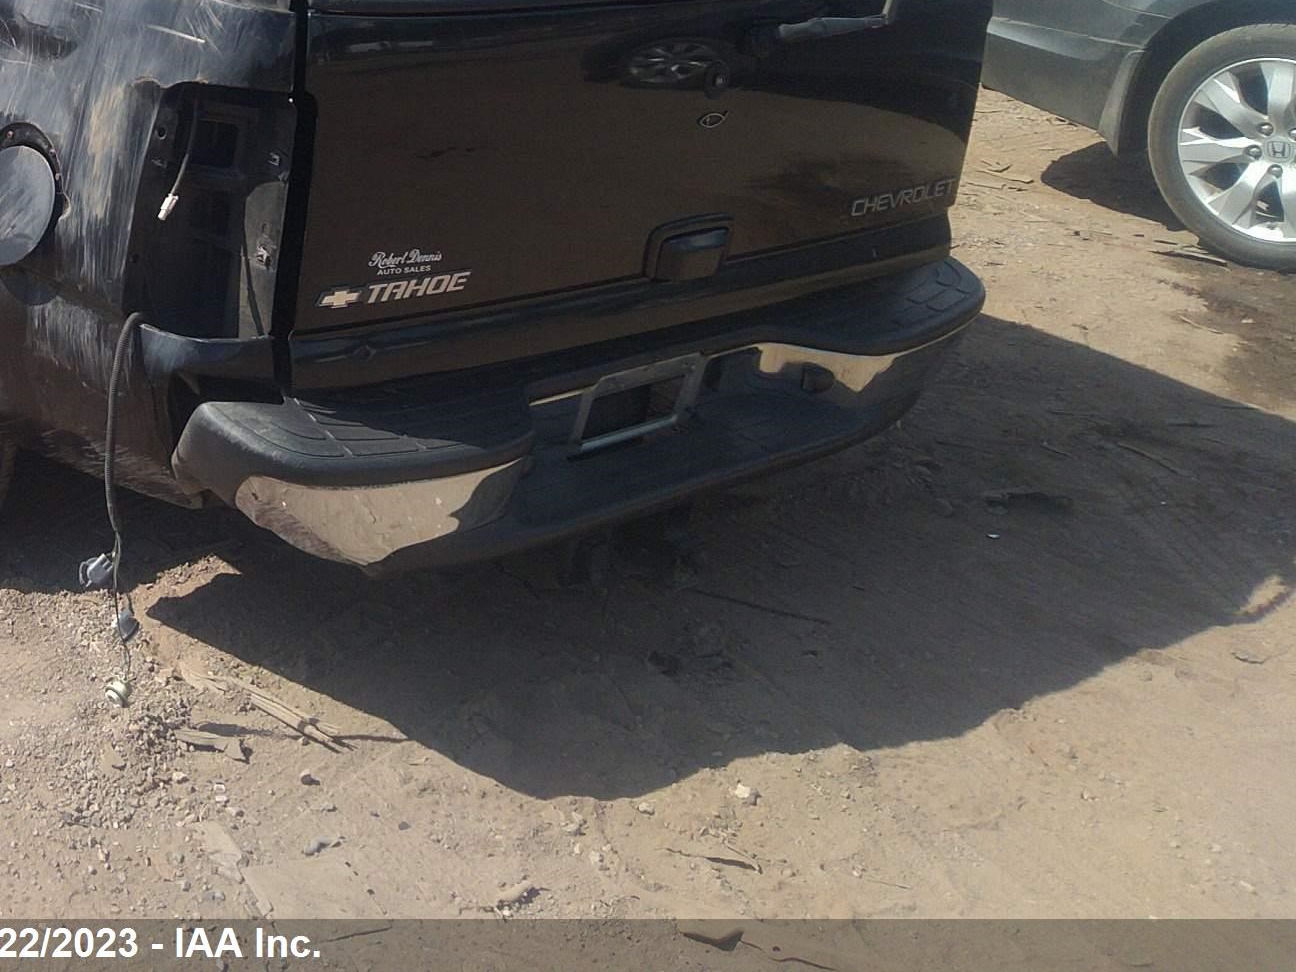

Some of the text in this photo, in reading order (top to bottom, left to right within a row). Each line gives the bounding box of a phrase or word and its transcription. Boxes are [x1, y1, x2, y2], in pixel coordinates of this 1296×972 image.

[851, 178, 957, 216] CHEVROLET
[368, 248, 442, 269] Robert Dennis
[376, 264, 432, 276] AUTO SALES
[367, 271, 472, 304] TAHOE
